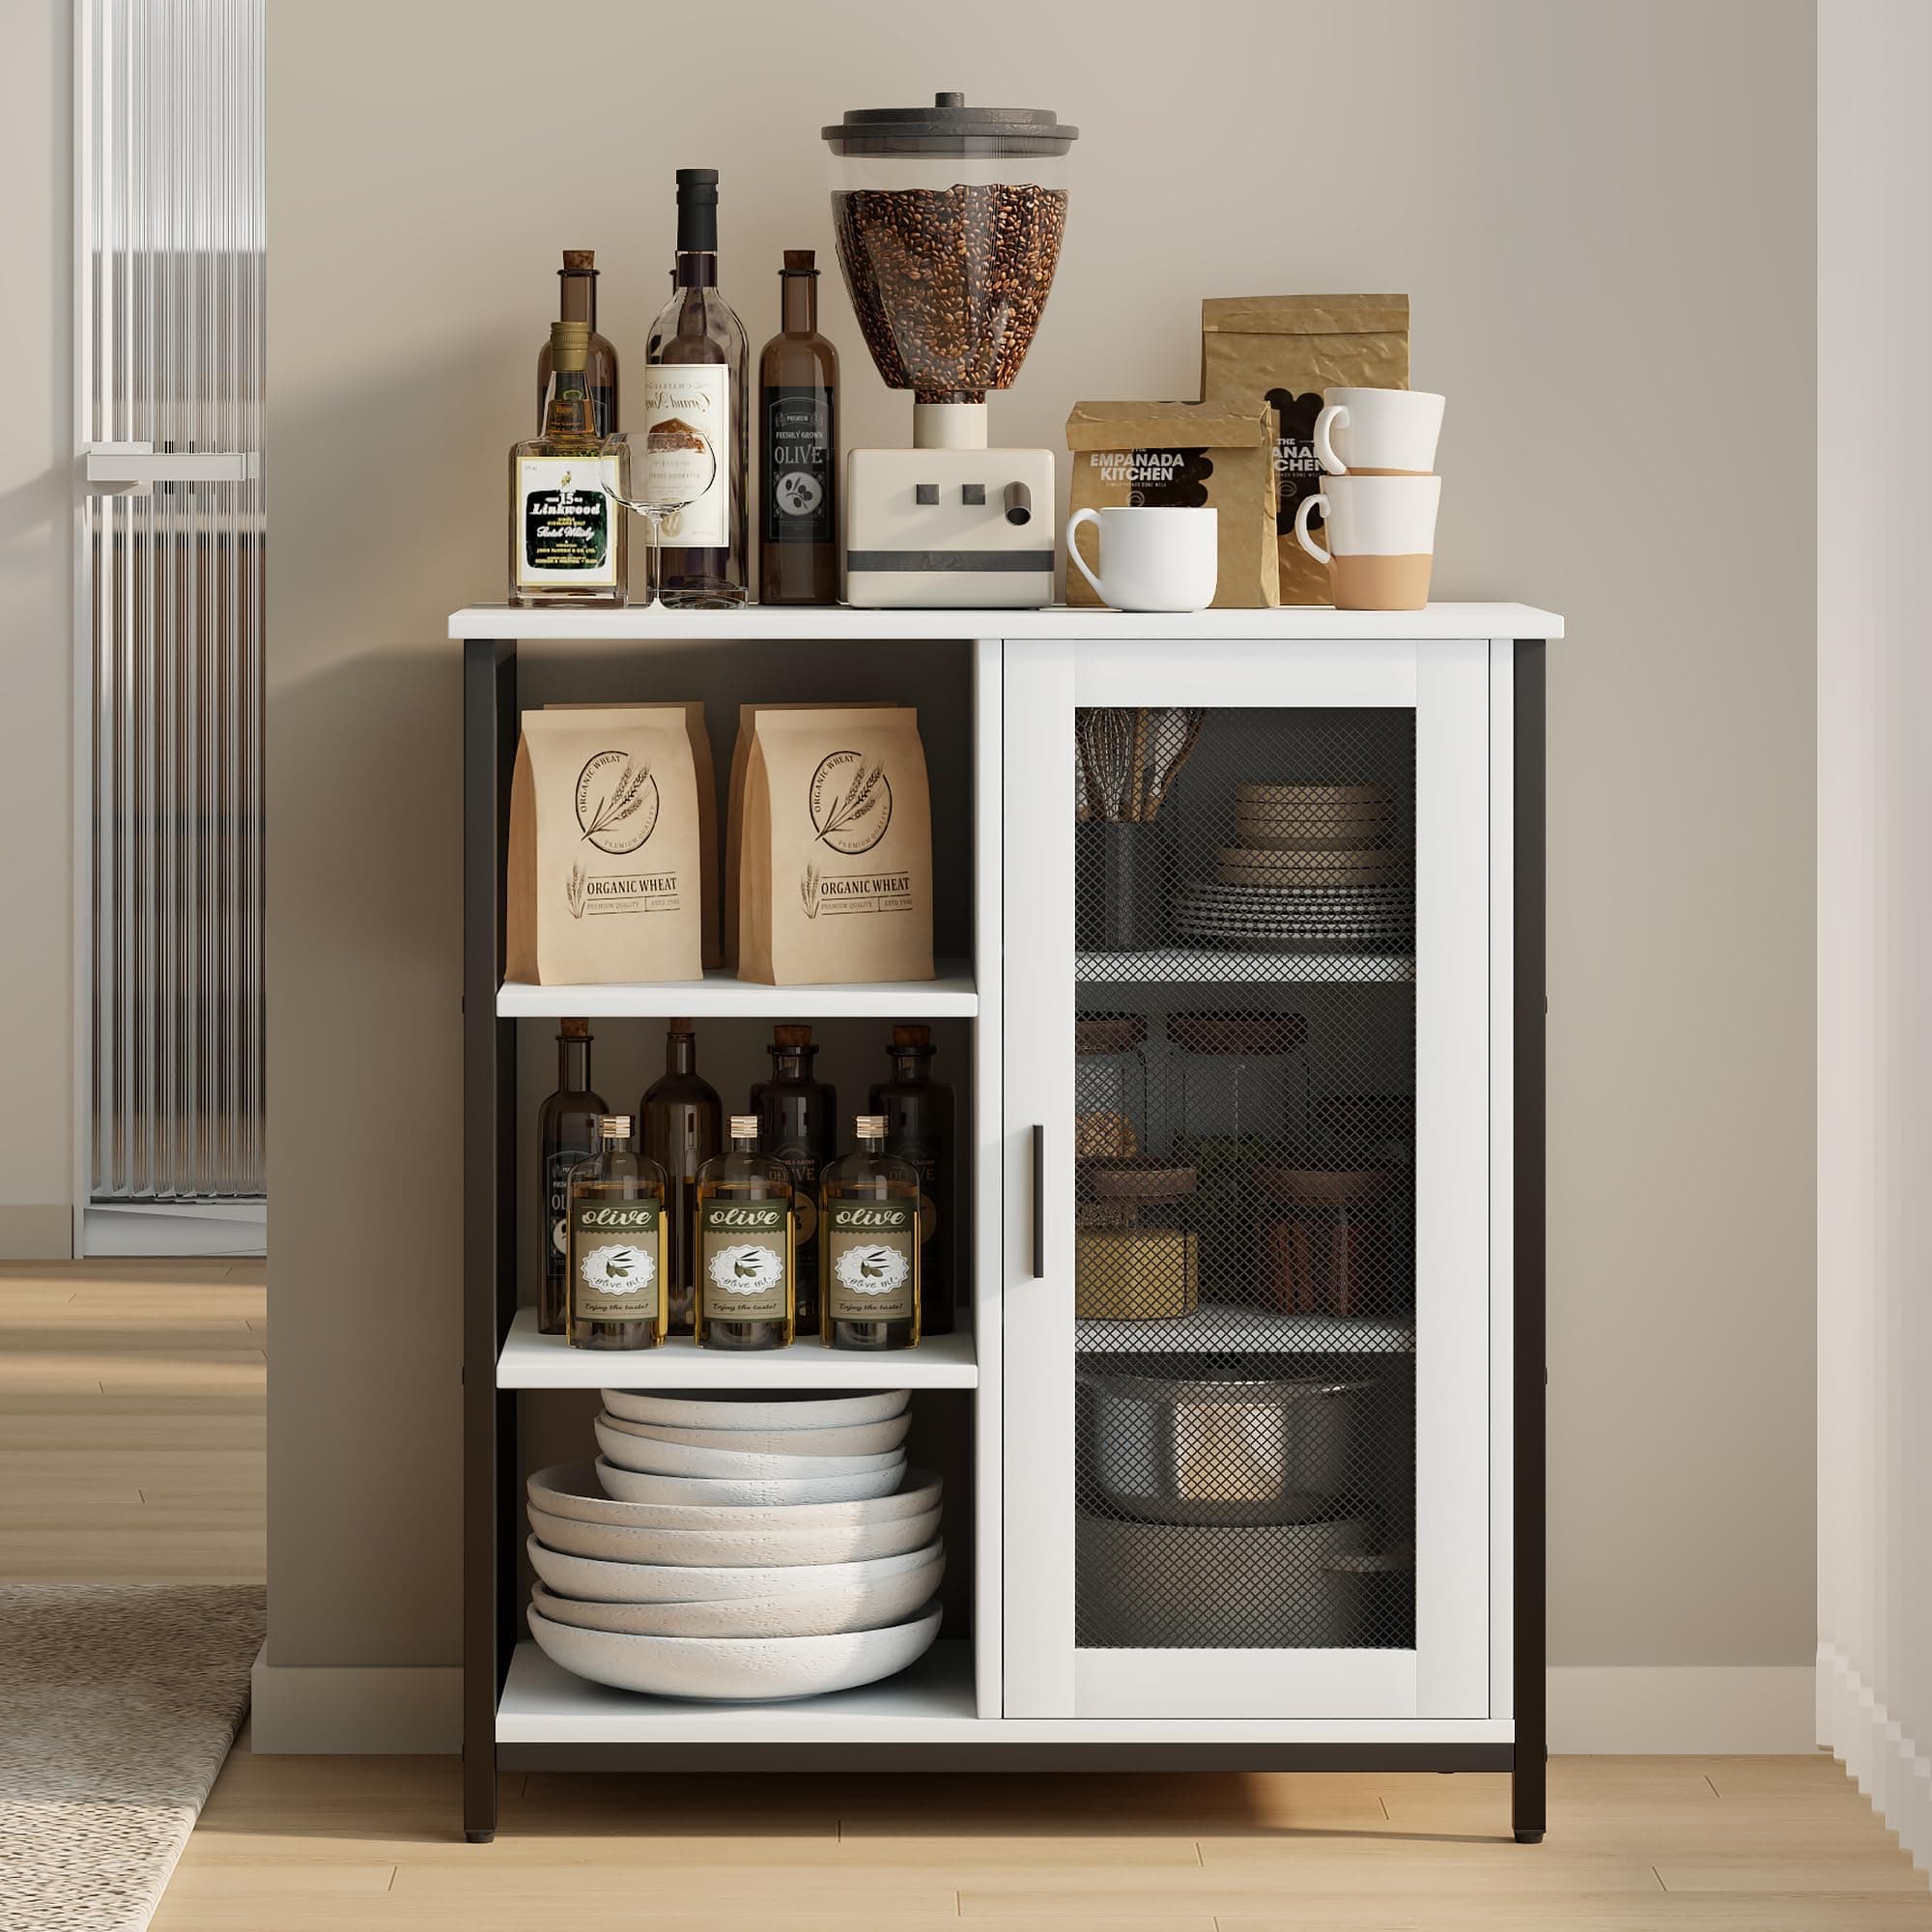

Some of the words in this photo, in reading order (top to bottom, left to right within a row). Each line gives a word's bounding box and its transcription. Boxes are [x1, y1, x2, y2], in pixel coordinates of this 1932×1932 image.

[774, 444, 823, 464] OLIVE
[1090, 453, 1185, 468] EMPANADA
[1273, 459, 1327, 471] CHEN
[1100, 468, 1174, 481] KITCHEN
[559, 493, 575, 504] 15
[529, 502, 601, 515] Linkwood
[579, 769, 595, 813] ORGANIC
[592, 754, 622, 771] WHEAT
[813, 769, 829, 813] ORGANIC
[825, 754, 855, 771] WHEAT
[586, 880, 638, 895] ORGANIC
[639, 877, 677, 893] WHEAT
[820, 880, 870, 895] ORGANIC
[872, 877, 910, 893] WHEAT
[582, 1208, 652, 1225] olive
[709, 1208, 781, 1225] olive
[836, 1208, 906, 1225] olive
[584, 1302, 607, 1311] Enjoy
[712, 1302, 735, 1311] Enjoy
[838, 1302, 862, 1311] Enjoy
